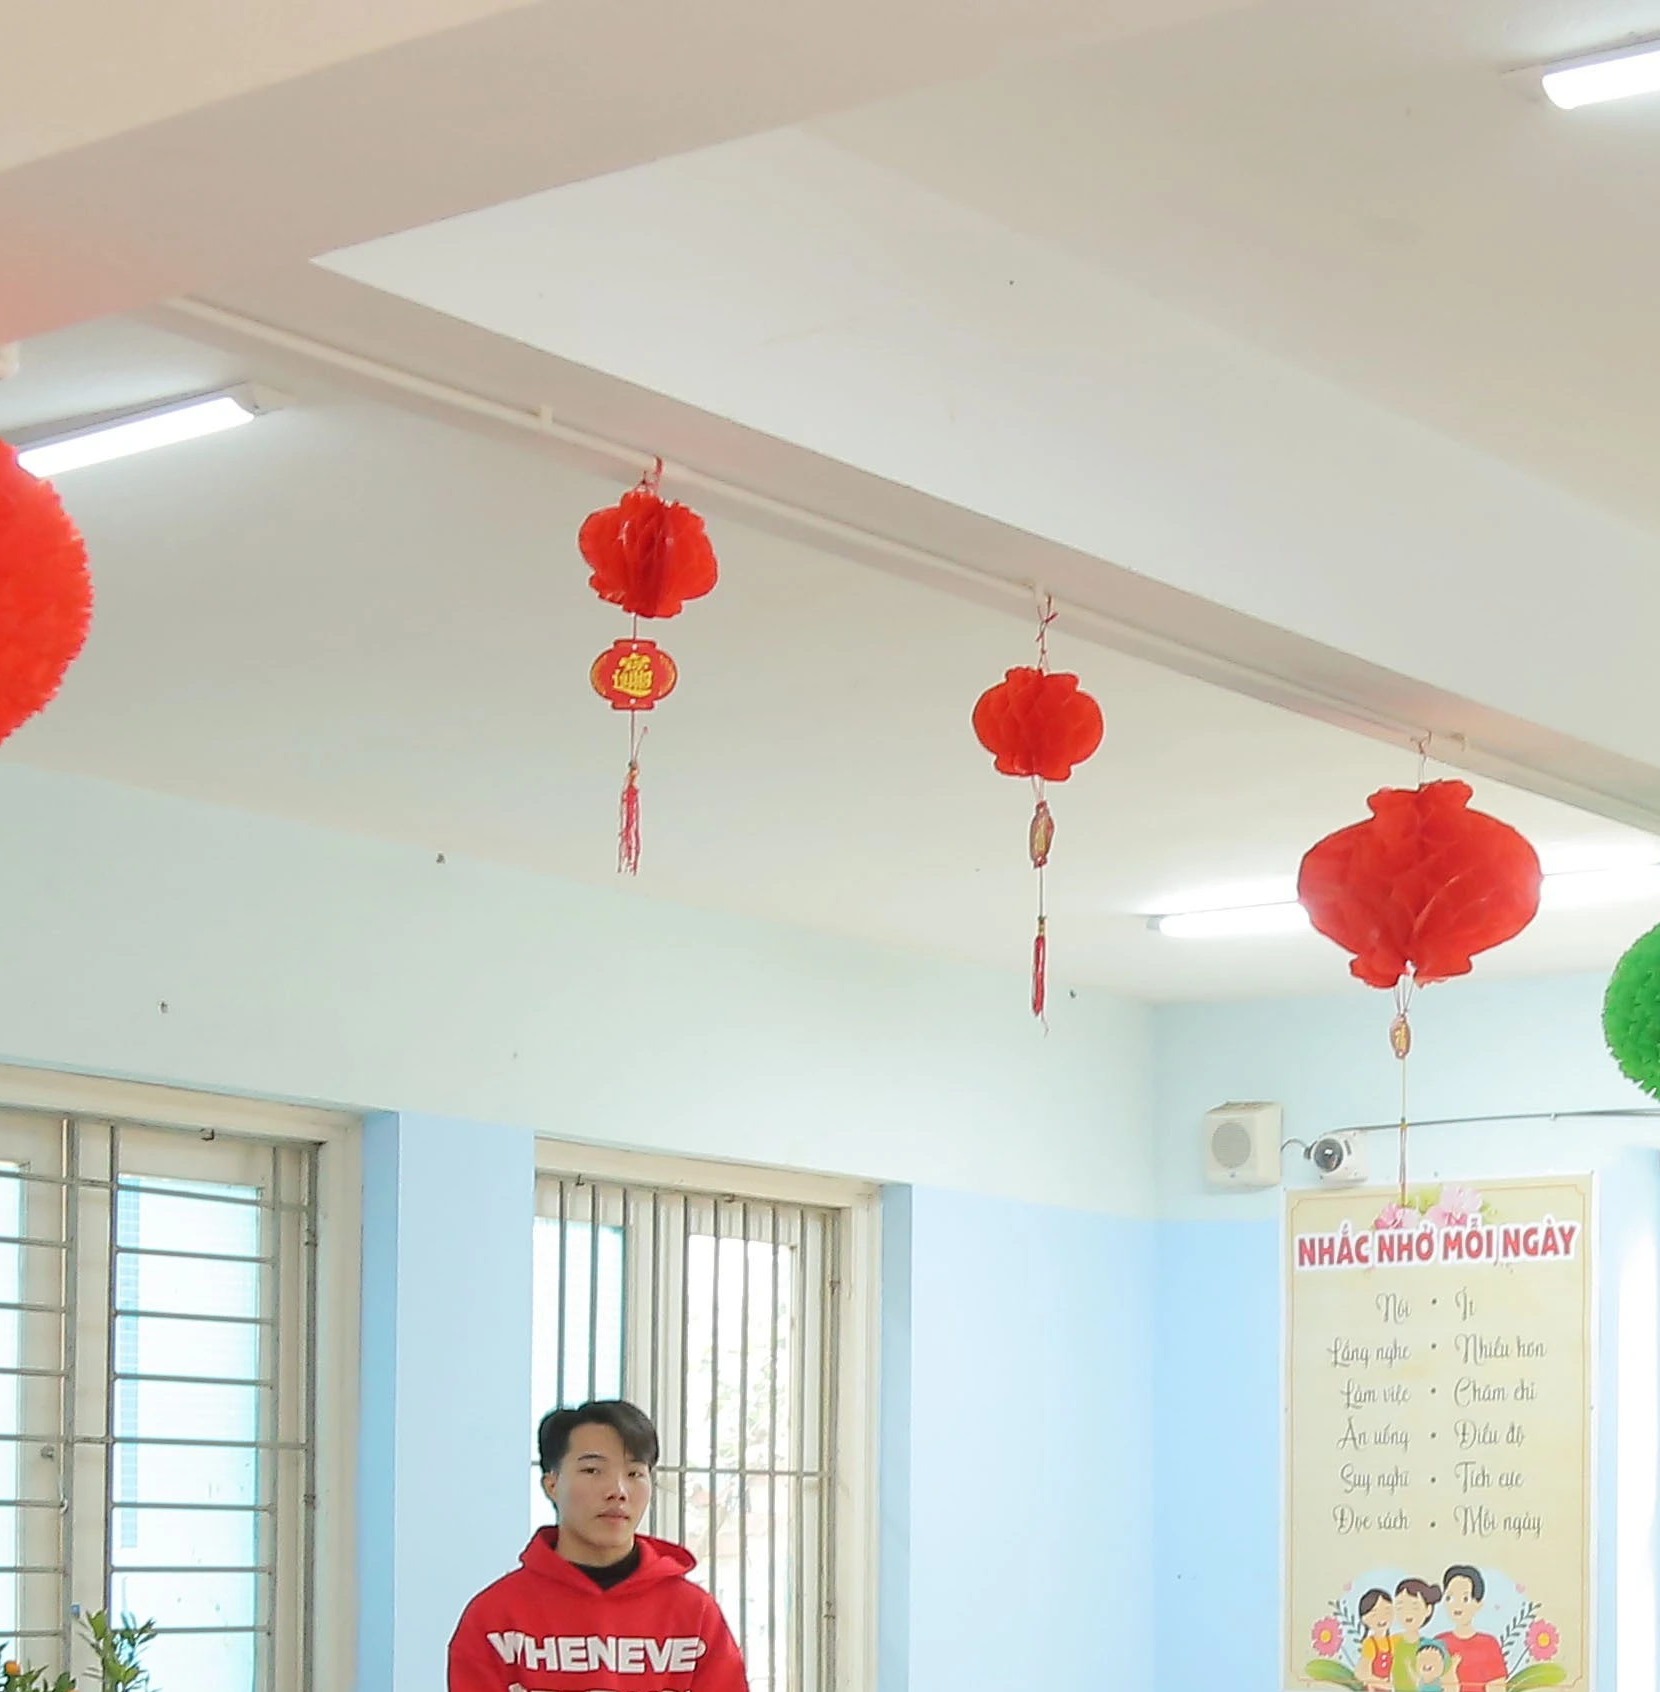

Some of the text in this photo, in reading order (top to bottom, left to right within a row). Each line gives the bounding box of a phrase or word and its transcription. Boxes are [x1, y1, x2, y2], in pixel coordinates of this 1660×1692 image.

[1297, 1217, 1578, 1267] NHẮC NHỞ MỖI NGÀY
[1375, 1286, 1476, 1325] Nói Ít
[1376, 1339, 1412, 1368] nghe
[1341, 1377, 1378, 1409] Làm
[1374, 1423, 1410, 1454] uống
[1340, 1463, 1371, 1495] Suy
[1453, 1461, 1491, 1493] Tích
[1377, 1508, 1410, 1530] sách
[1503, 1511, 1543, 1539] ngày
